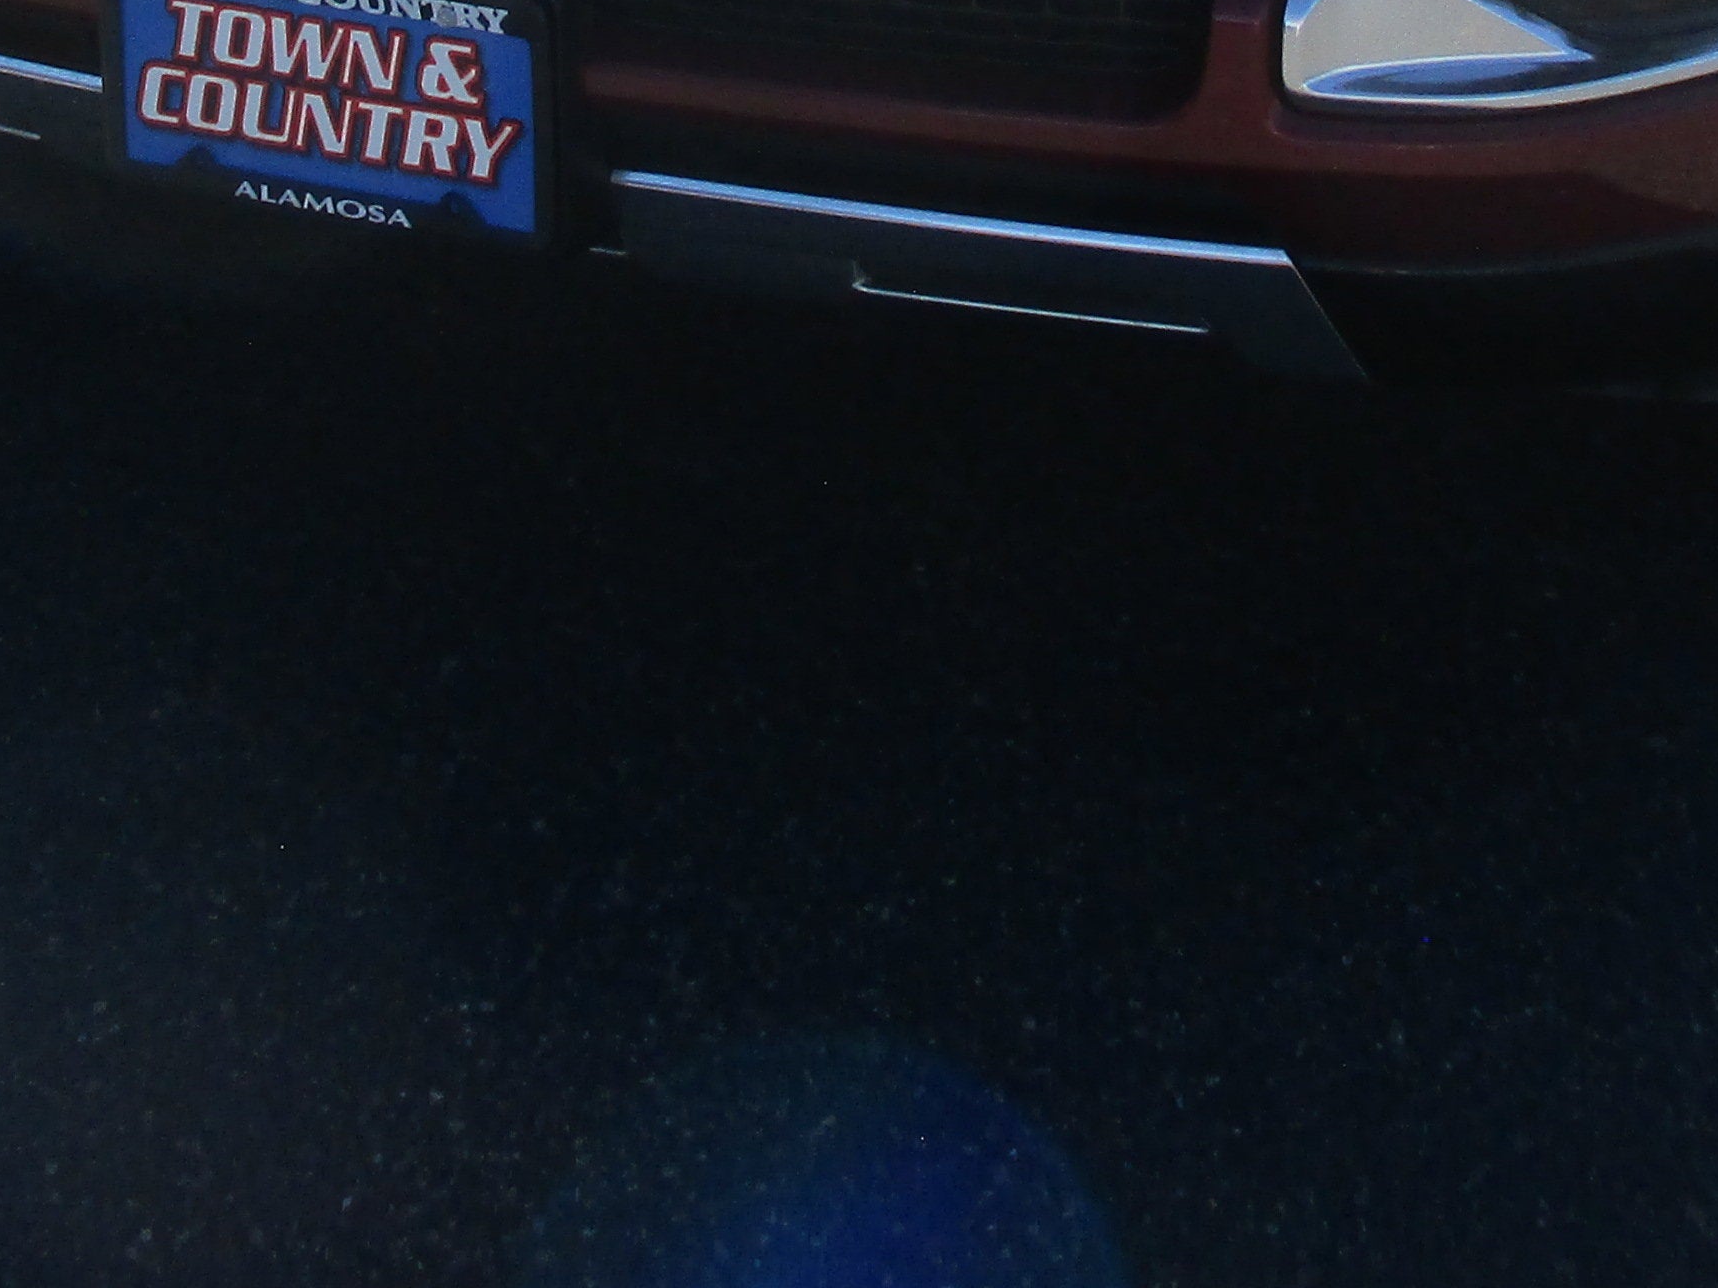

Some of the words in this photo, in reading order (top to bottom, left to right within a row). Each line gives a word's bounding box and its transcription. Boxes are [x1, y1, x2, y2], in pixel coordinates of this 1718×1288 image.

[417, 38, 480, 107] &
[140, 65, 518, 181] COUNTRY
[235, 180, 411, 228] ALAMOSA
